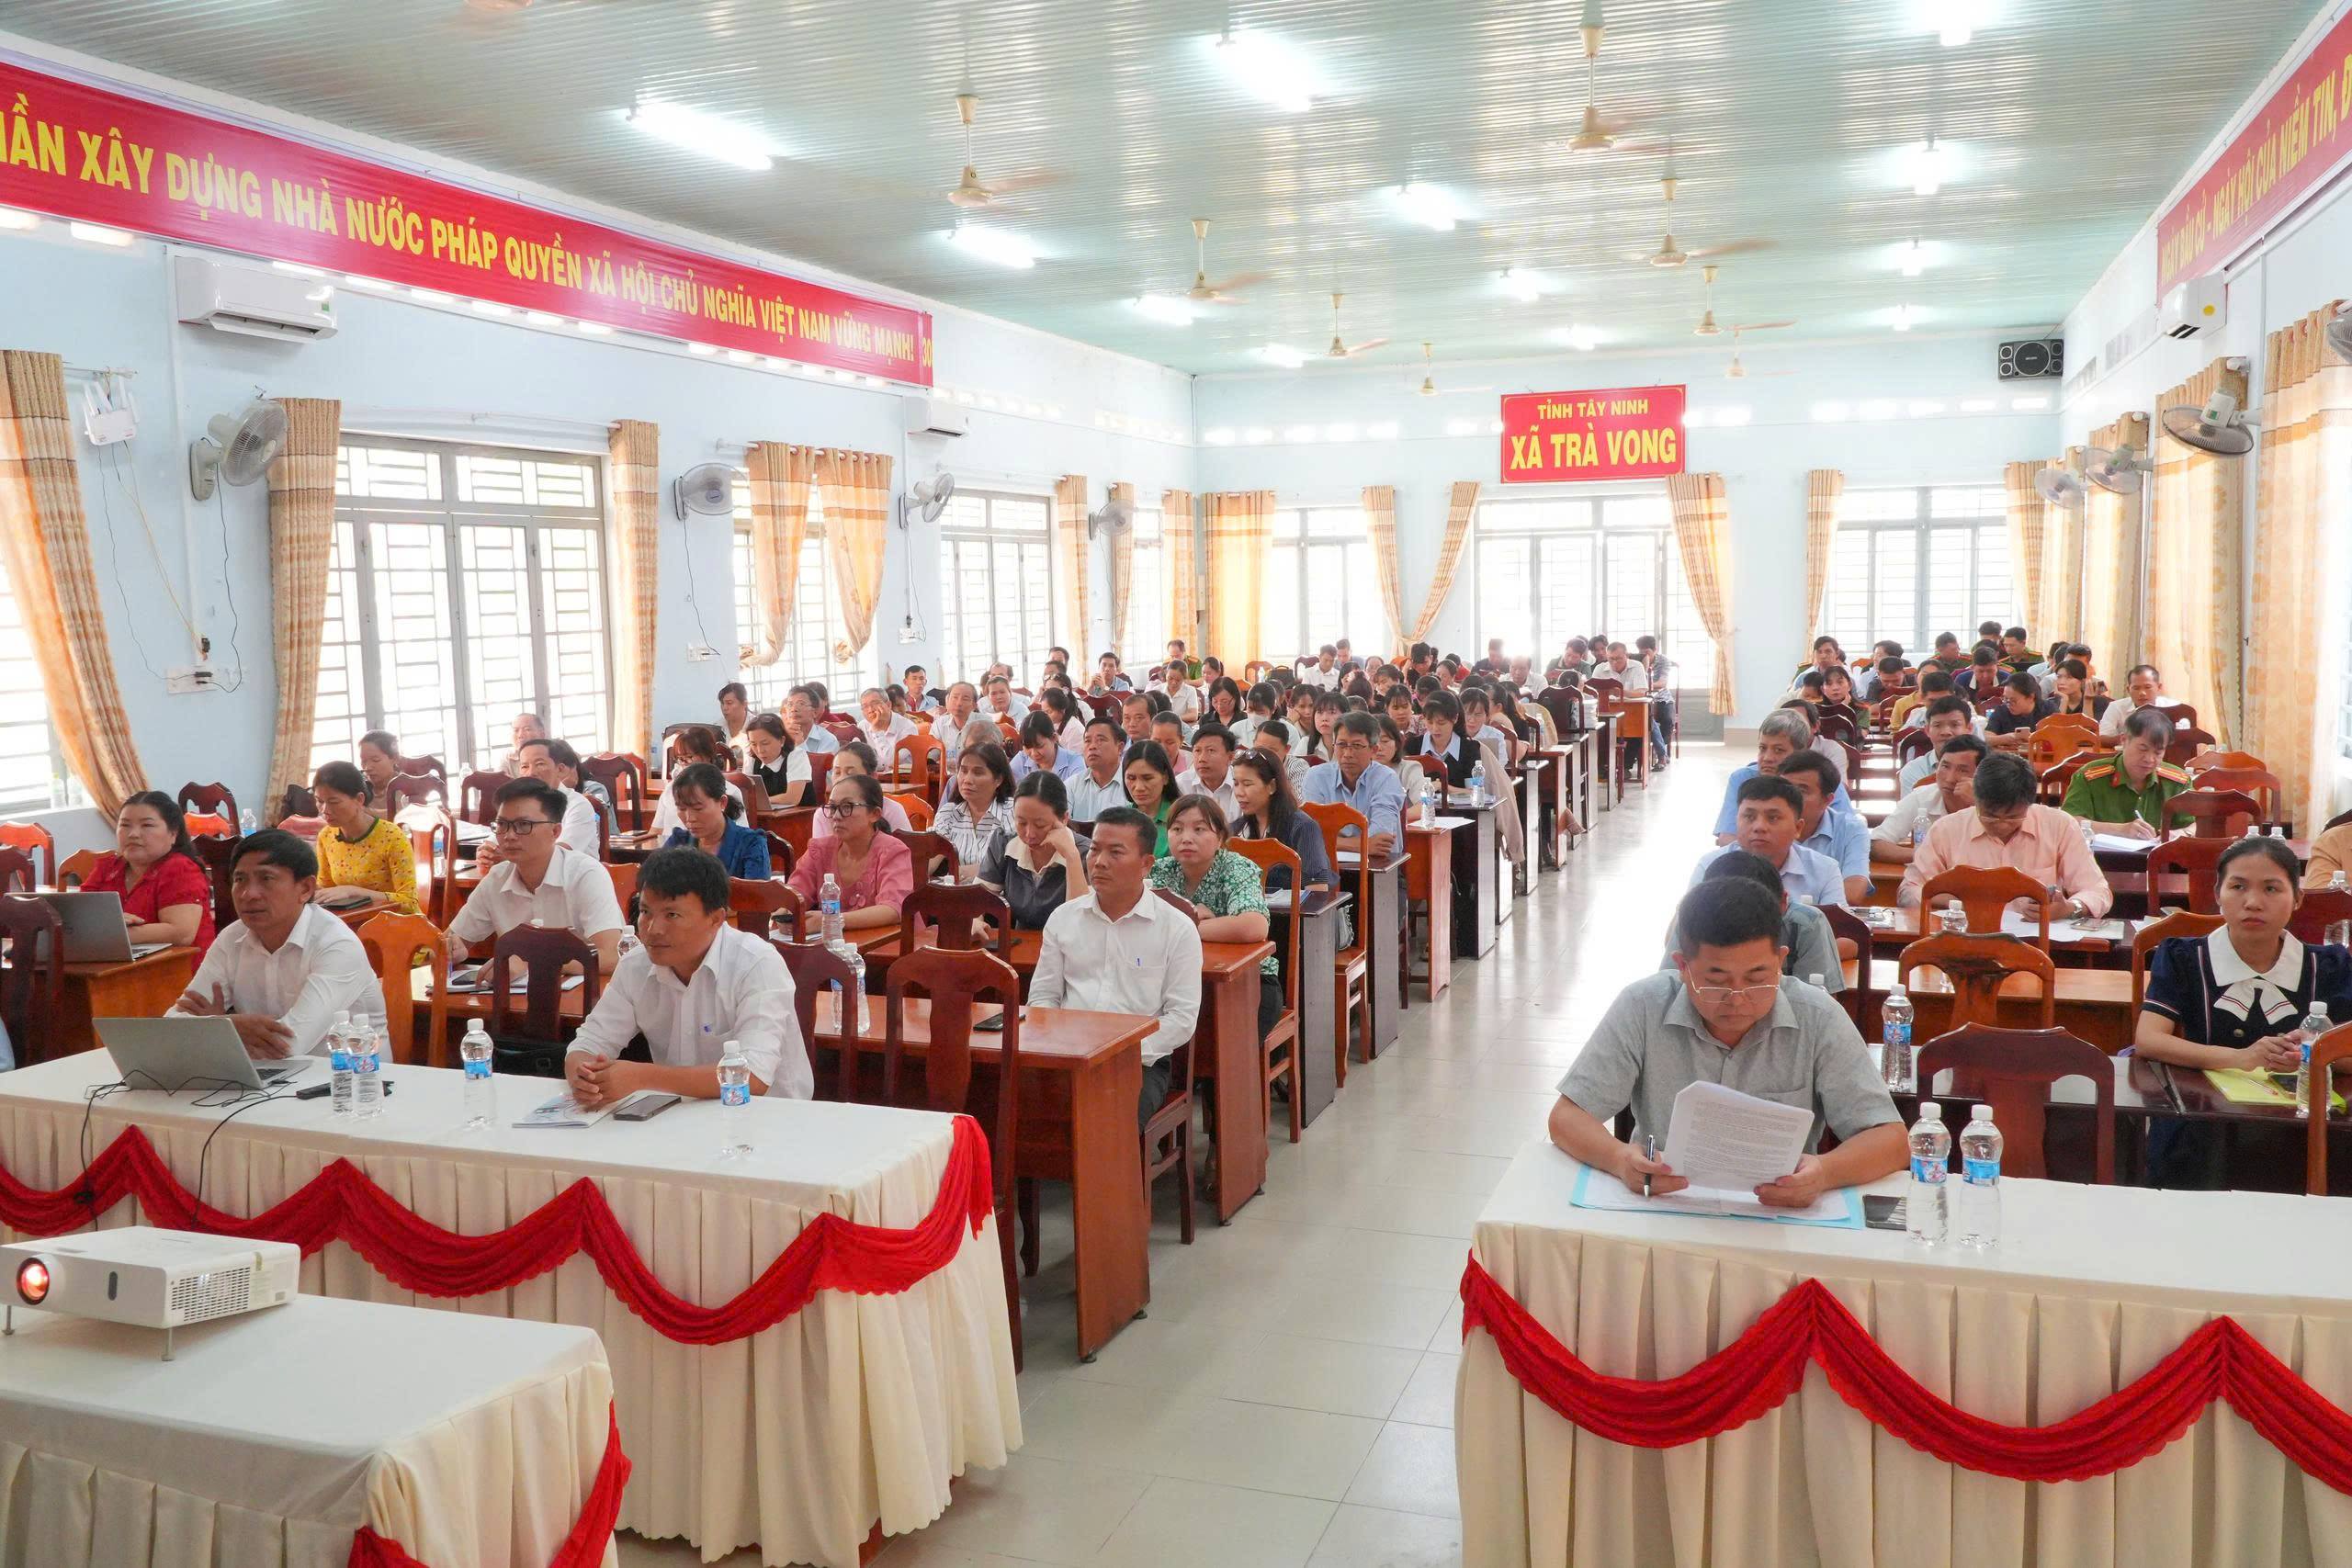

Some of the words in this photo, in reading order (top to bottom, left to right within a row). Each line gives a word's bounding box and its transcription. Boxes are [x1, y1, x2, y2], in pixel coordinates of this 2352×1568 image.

[2162, 226, 2180, 288] NGÀY
[2179, 204, 2195, 270] BẦU
[2195, 188, 2207, 256] CỬ
[2212, 166, 2237, 241] NGÀY
[2237, 147, 2256, 227] HỘI
[2256, 118, 2277, 201] CỦA
[2279, 83, 2311, 180] NIỀM
[2312, 69, 2337, 148] TIN,
[77, 127, 154, 194] XÂY
[165, 152, 263, 221] DỰNG
[272, 177, 338, 236] NHÀ
[345, 195, 424, 255] NƯỚC
[430, 216, 498, 270] PHÁP
[505, 231, 583, 289] QUYỀN
[587, 250, 617, 297] XÃ
[621, 261, 656, 315] HỘI
[661, 268, 698, 316] CHỦ
[703, 284, 757, 328] NGHĨA
[759, 296, 795, 344] VIỆT
[798, 308, 831, 344] NAM
[833, 310, 872, 354] VỮNG
[874, 325, 914, 366] MẠNH!
[1510, 425, 1544, 469] XÃ
[1550, 423, 1600, 468] TRÀ
[1607, 427, 1677, 466] VONG
[1537, 399, 1573, 420] TỈNH
[1577, 399, 1606, 418] TÂY
[1611, 399, 1648, 416] NINH
